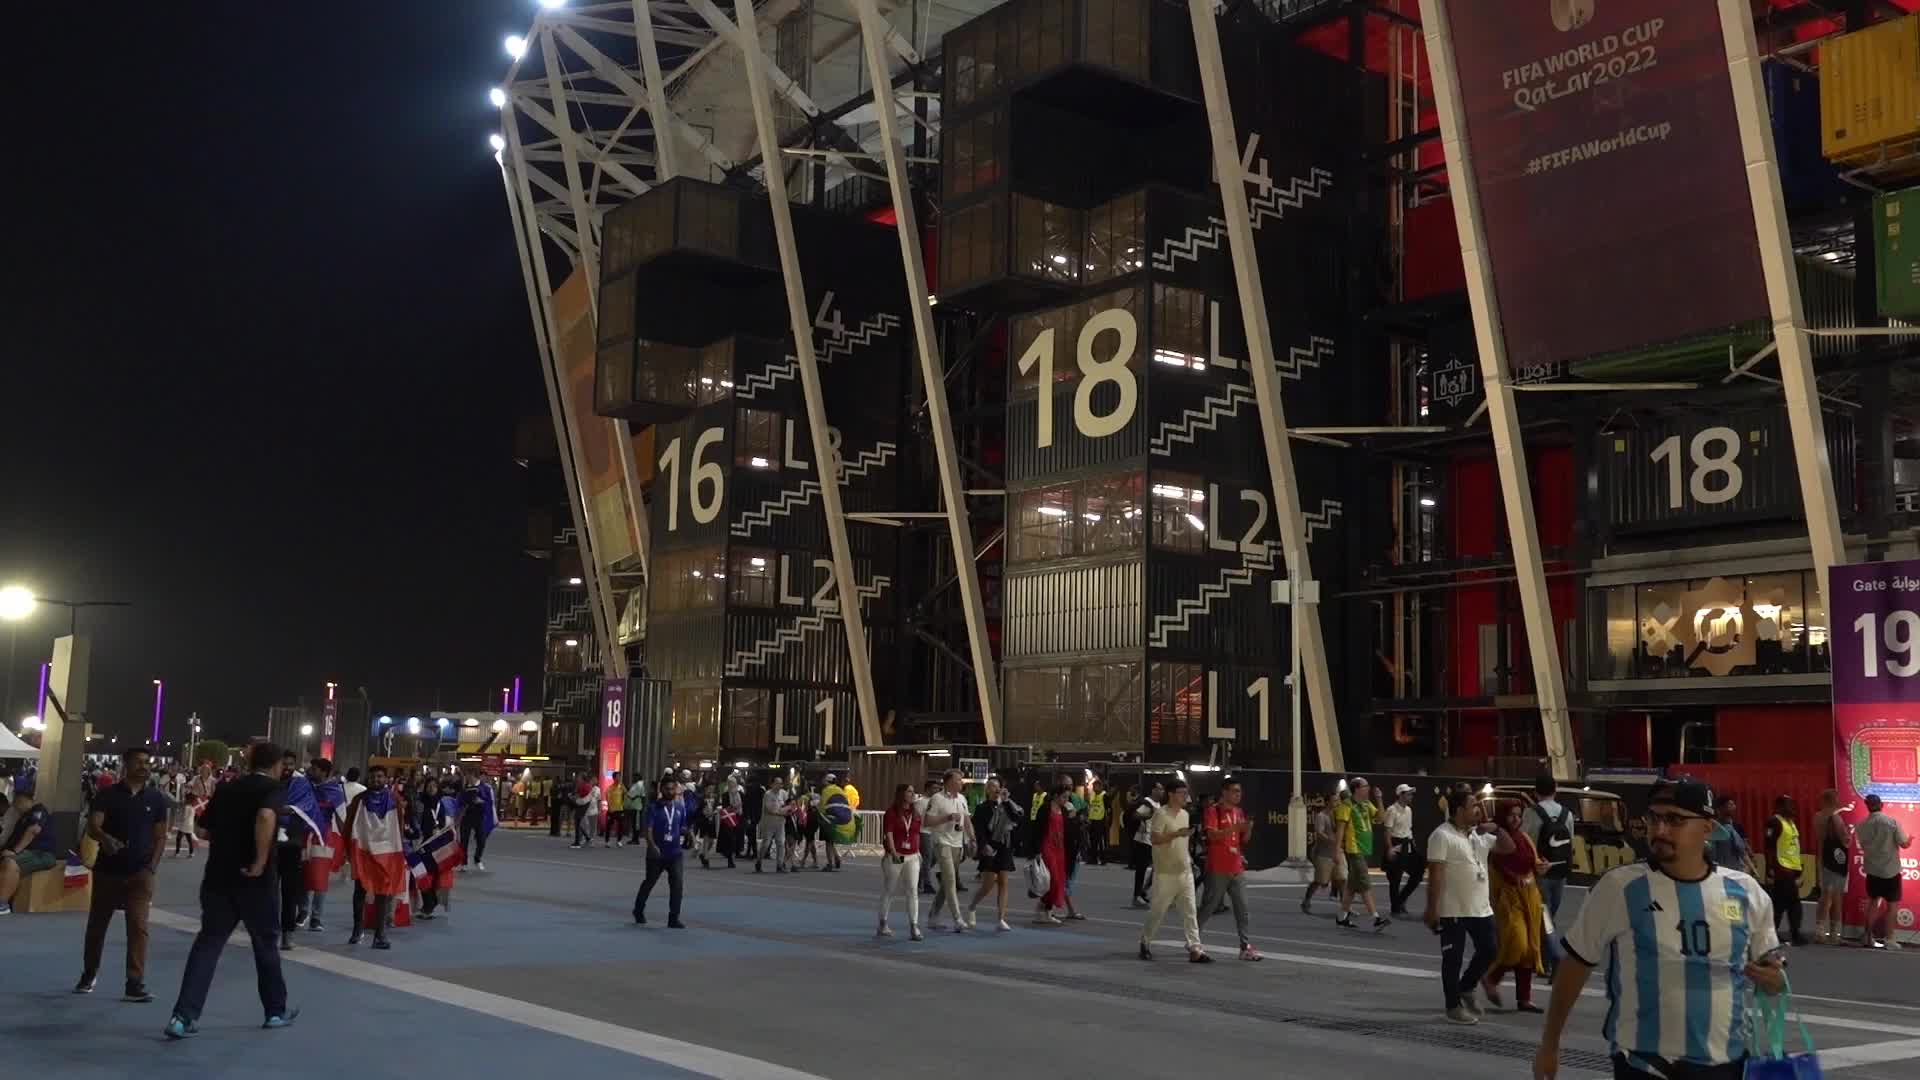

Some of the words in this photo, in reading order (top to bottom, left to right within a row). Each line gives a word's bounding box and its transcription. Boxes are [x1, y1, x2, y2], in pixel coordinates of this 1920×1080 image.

[1503, 61, 1544, 89] FIFA
[1544, 35, 1619, 73] WORLD
[1622, 17, 1664, 46] CUP
[1514, 45, 1657, 111] Qatar2022
[1526, 121, 1671, 175] #FIFAWorldCup
[1017, 308, 1138, 448] 18
[658, 427, 725, 531] 16
[1650, 426, 1743, 509] 18
[1209, 483, 1267, 554] L2
[780, 554, 838, 608] L2
[1853, 579, 1887, 592] Gate
[1854, 609, 1920, 678] 19
[607, 699, 621, 728] 18
[775, 693, 833, 746] L1
[1208, 671, 1269, 741] L1
[1676, 919, 1711, 957] 10
